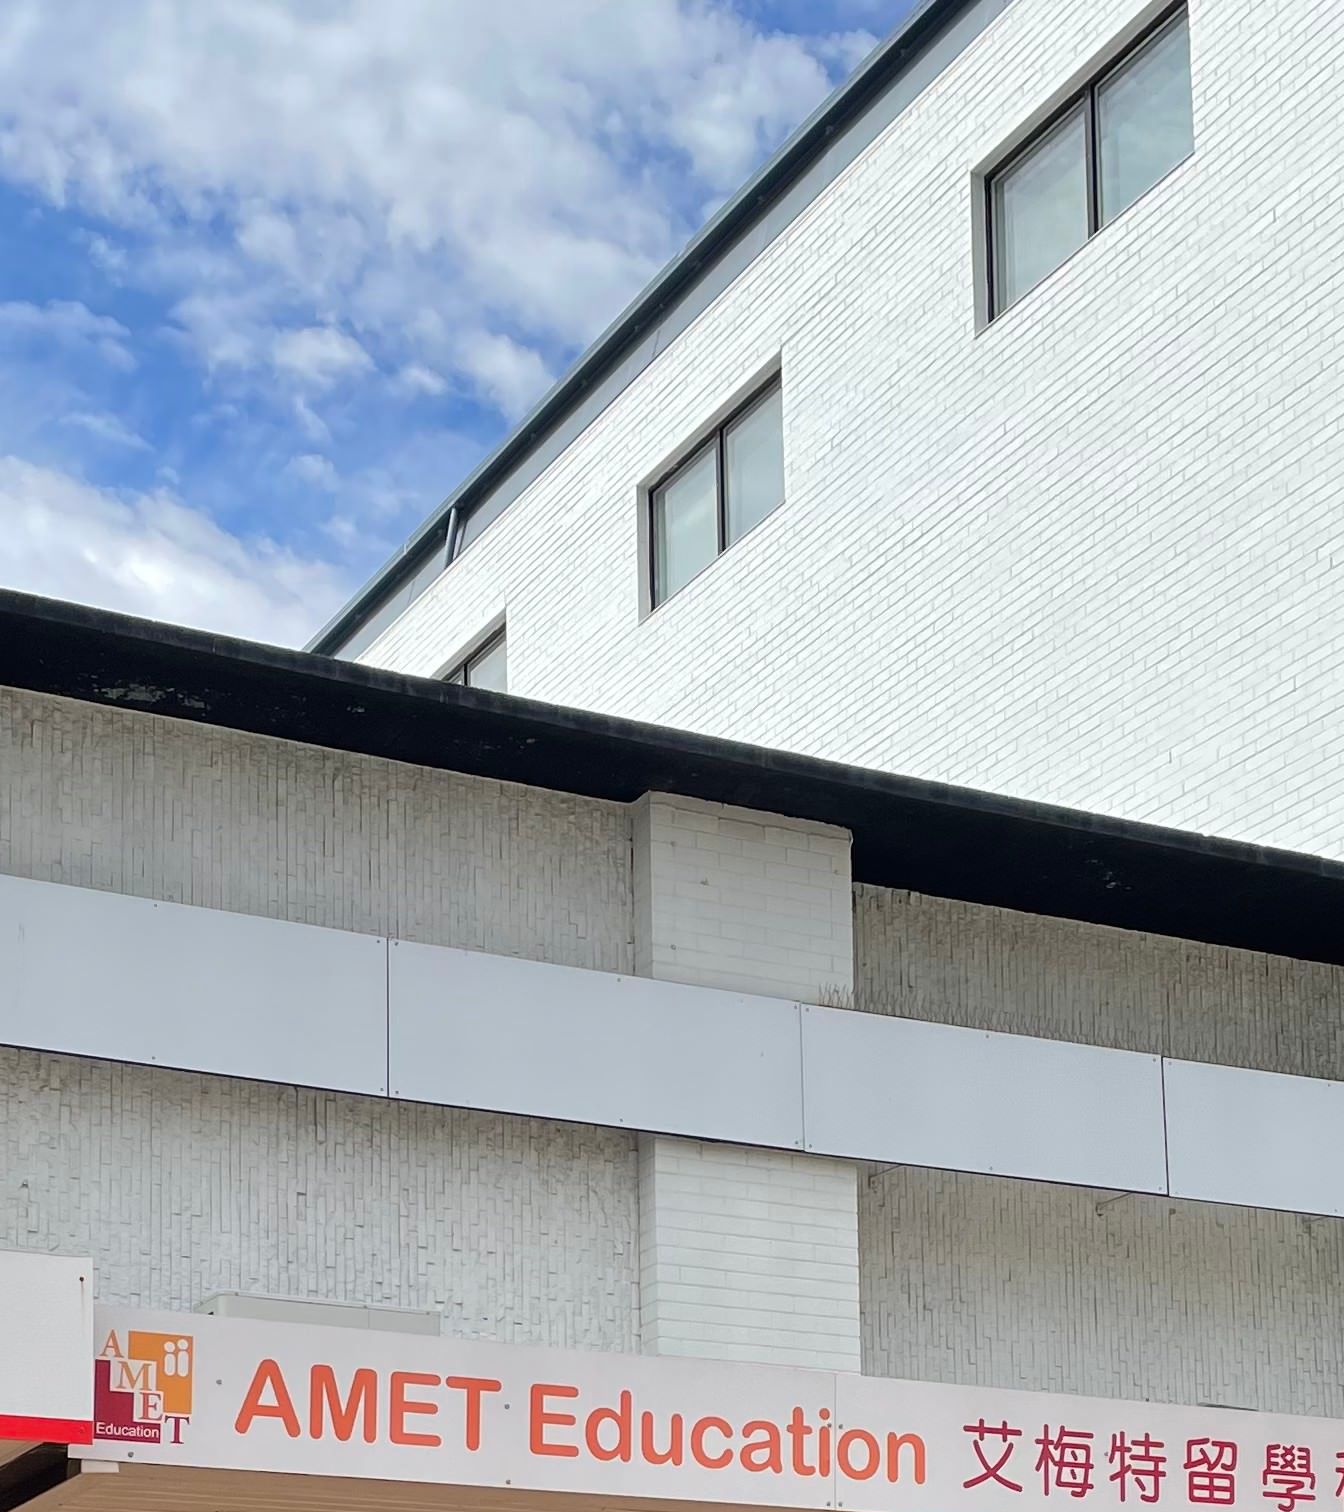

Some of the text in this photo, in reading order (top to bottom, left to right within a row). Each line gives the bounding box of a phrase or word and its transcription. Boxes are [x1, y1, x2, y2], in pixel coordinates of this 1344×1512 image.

[96, 1422, 159, 1438] Education
[234, 1358, 927, 1485] AMET Education
